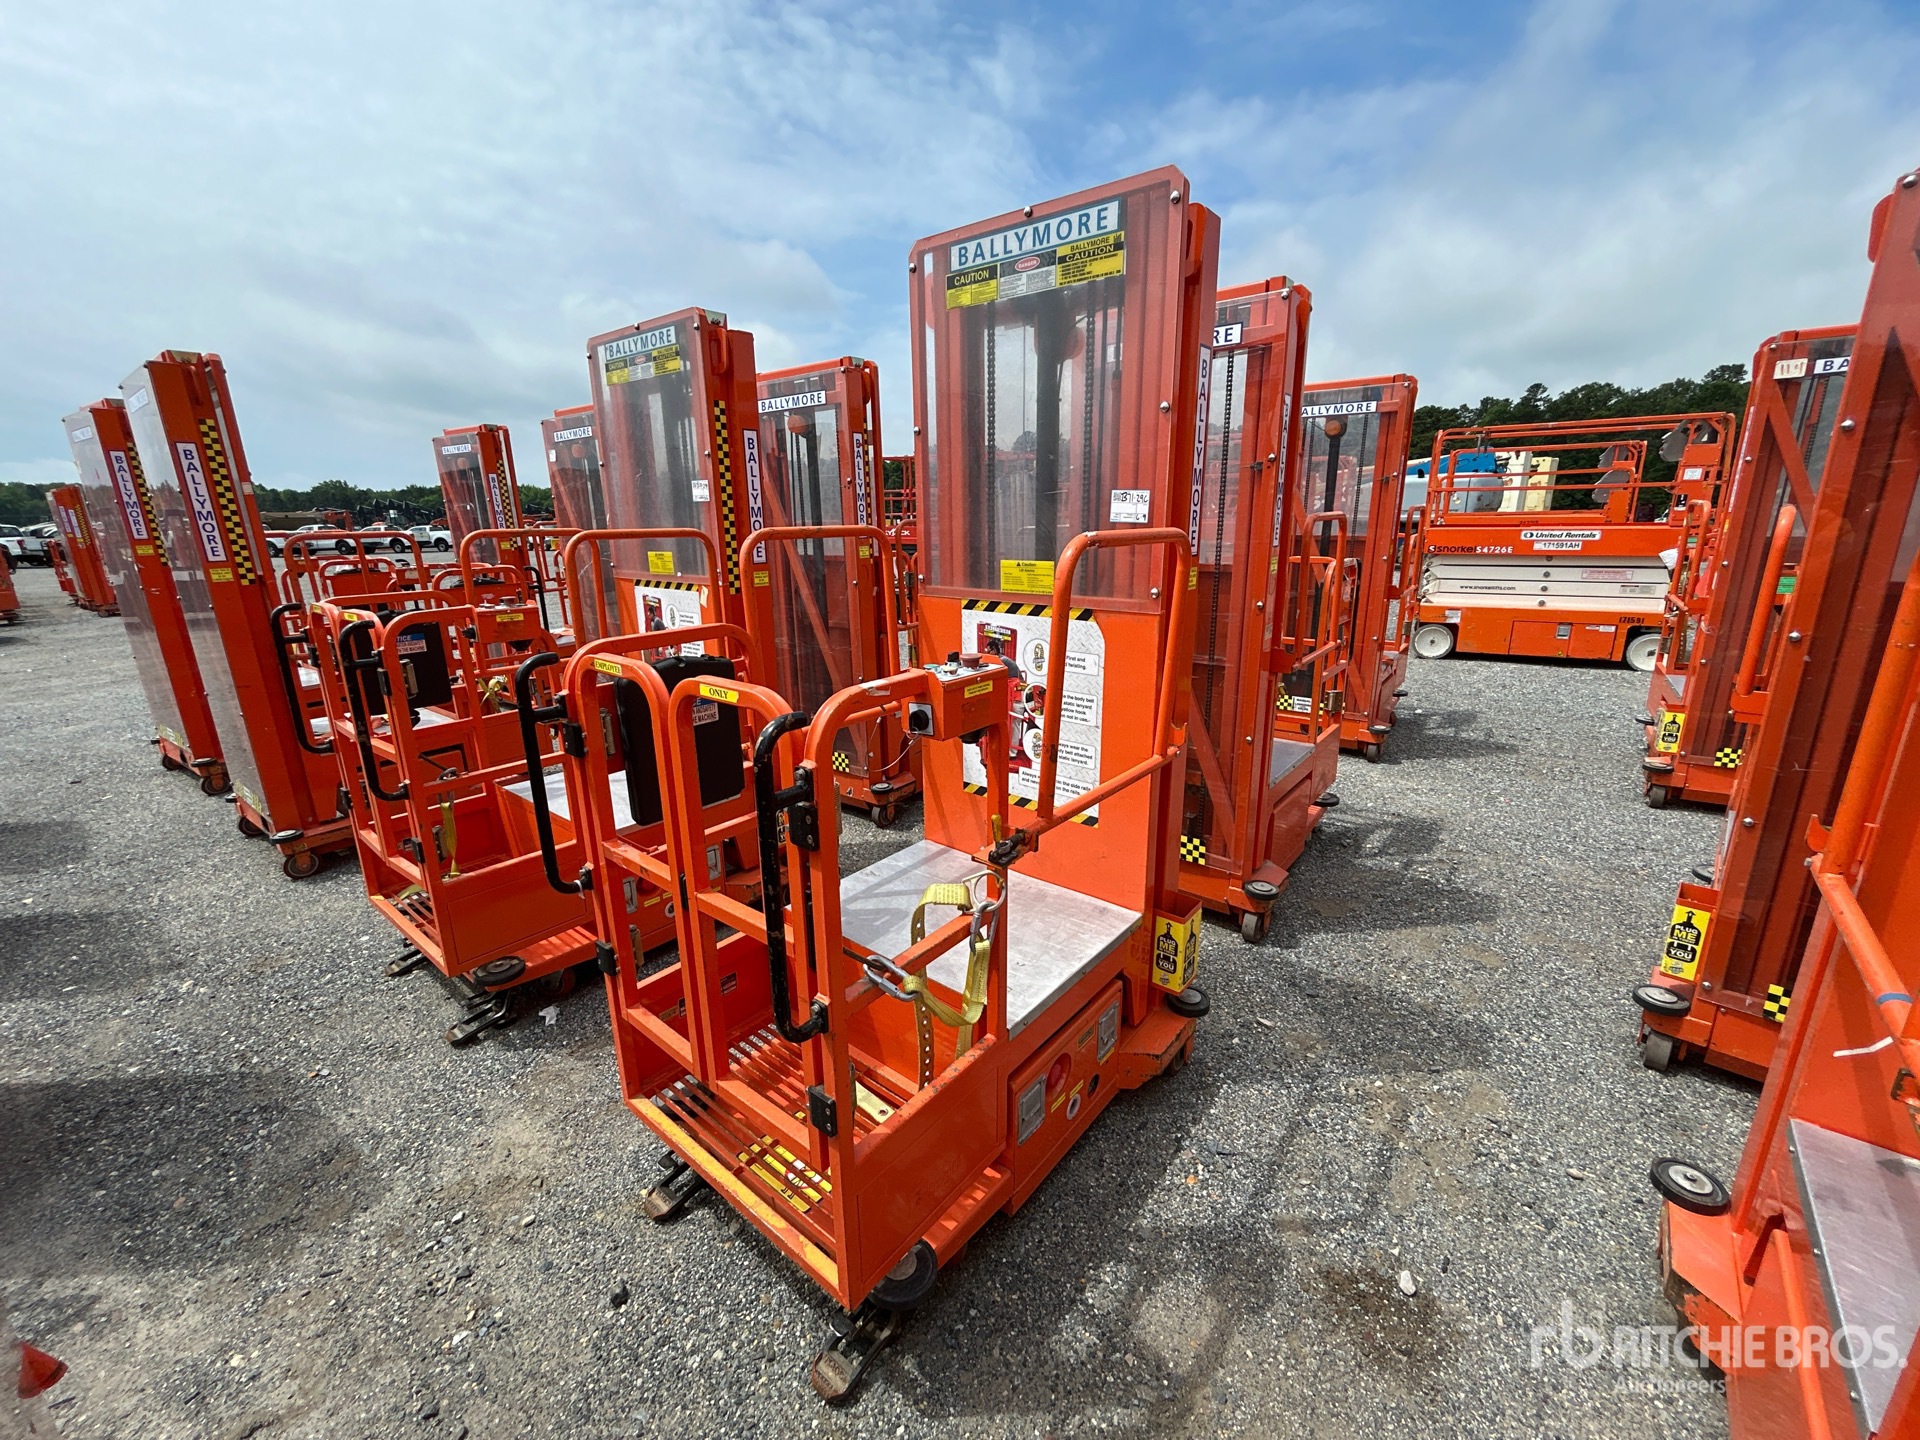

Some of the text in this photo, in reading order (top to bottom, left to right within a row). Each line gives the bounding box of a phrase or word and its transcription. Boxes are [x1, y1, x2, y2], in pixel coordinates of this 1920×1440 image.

[958, 207, 1108, 266] BALLYMORE
[1070, 236, 1110, 252] BALLYMORE
[1066, 245, 1114, 261] CAUTION
[954, 269, 989, 285] CAUTION
[609, 329, 671, 357] BALLYMORE
[761, 393, 822, 411] BALLYMORE
[555, 428, 591, 441] BALLYMORE
[1191, 358, 1207, 548] BALLYMORE
[114, 455, 144, 536] BALLYMORE
[183, 449, 220, 557] BALLYMORE
[747, 438, 762, 558] BALLYMOE
[1619, 616, 1645, 624] 171591
[596, 660, 621, 674] EMPLOYEE
[709, 687, 728, 699] ONLY
[1673, 930, 1697, 941] ME
[1674, 924, 1698, 935] PLUG
[1160, 936, 1176, 946] PLUG
[1160, 941, 1175, 951] ME
[1670, 948, 1692, 959] YOU
[1159, 960, 1174, 971] YOU
